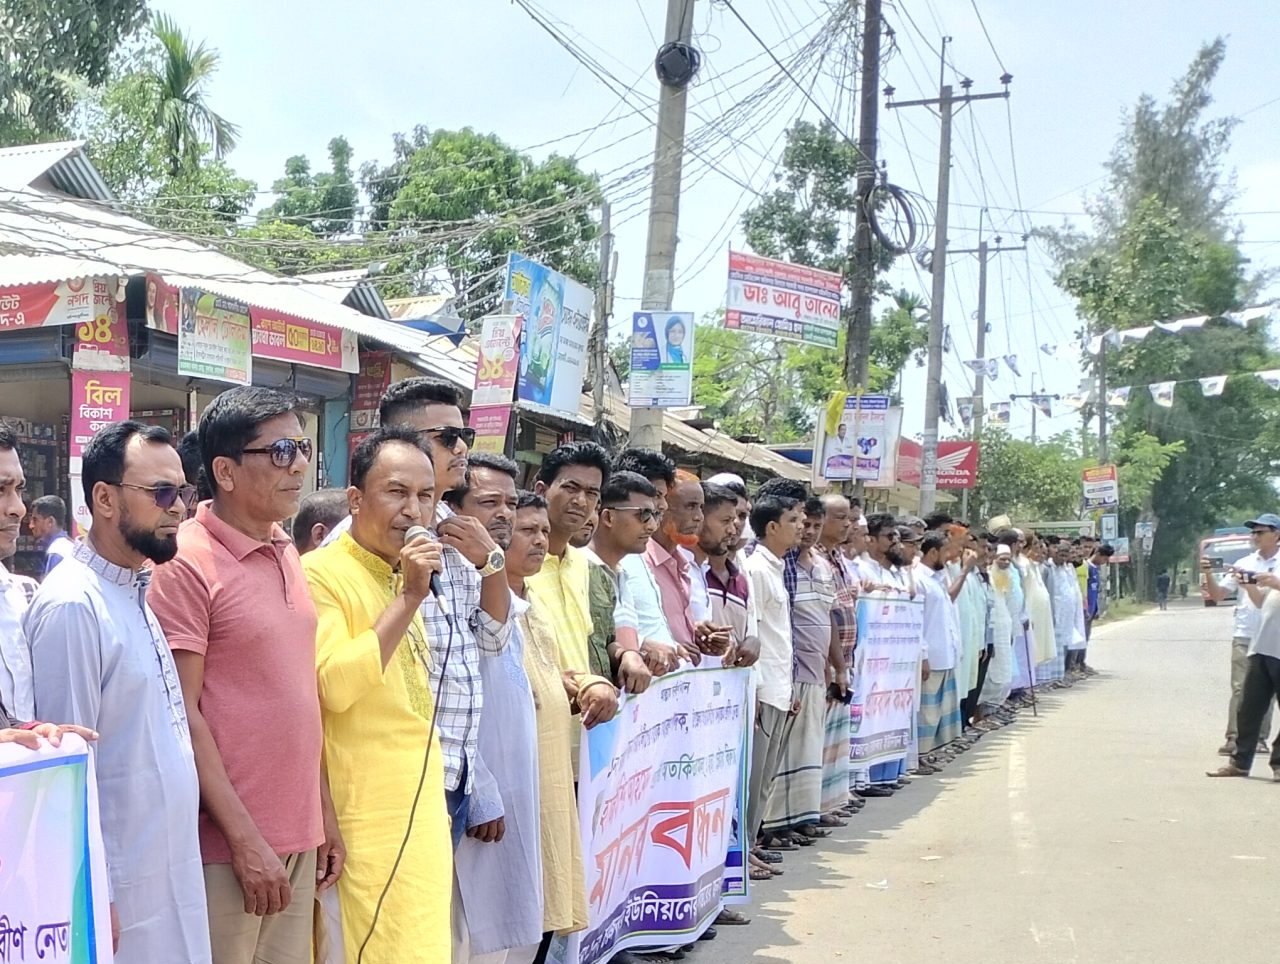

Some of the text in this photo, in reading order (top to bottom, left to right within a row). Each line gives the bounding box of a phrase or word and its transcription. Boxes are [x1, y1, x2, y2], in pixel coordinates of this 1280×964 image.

[68, 294, 89, 307] নগদ
[743, 284, 768, 305] ডাঃ
[772, 289, 801, 319] আবু
[85, 380, 122, 406] বিল
[79, 404, 113, 419] বিকাশ
[623, 891, 697, 926] ইউনিয়নের
